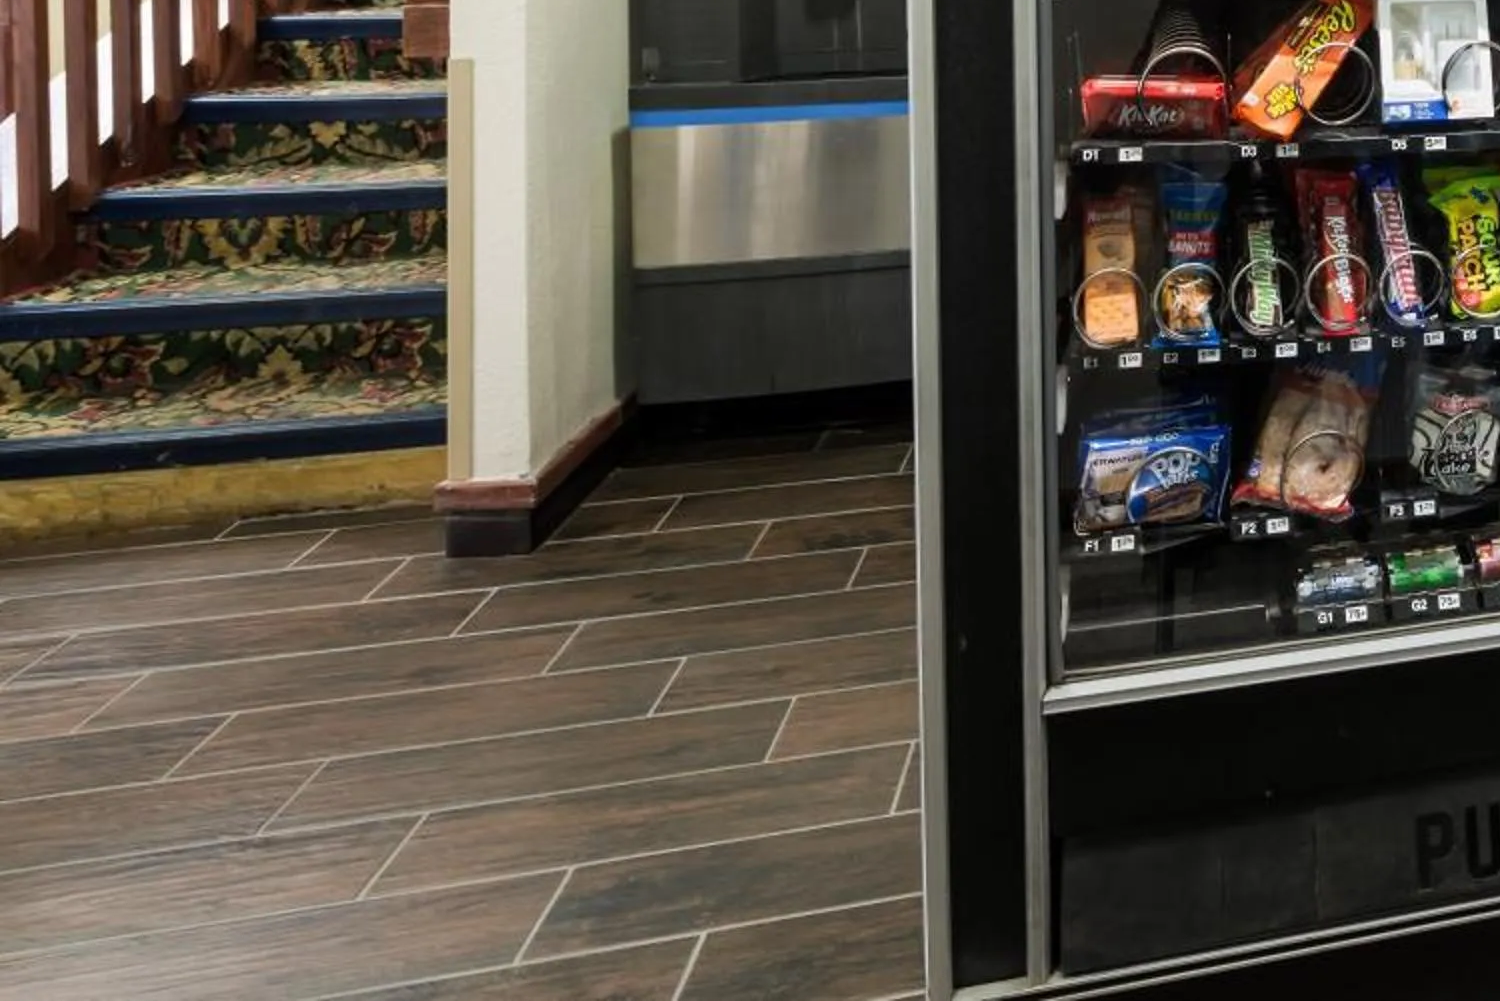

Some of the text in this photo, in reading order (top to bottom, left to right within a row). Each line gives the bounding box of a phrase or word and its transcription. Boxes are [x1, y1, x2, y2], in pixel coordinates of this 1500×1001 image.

[1083, 149, 1099, 162] D1
[1458, 216, 1487, 292] PATCH
[1391, 336, 1406, 347] E5
[1241, 521, 1257, 535] F2
[1084, 539, 1099, 552] F1
[1317, 610, 1333, 623] G1
